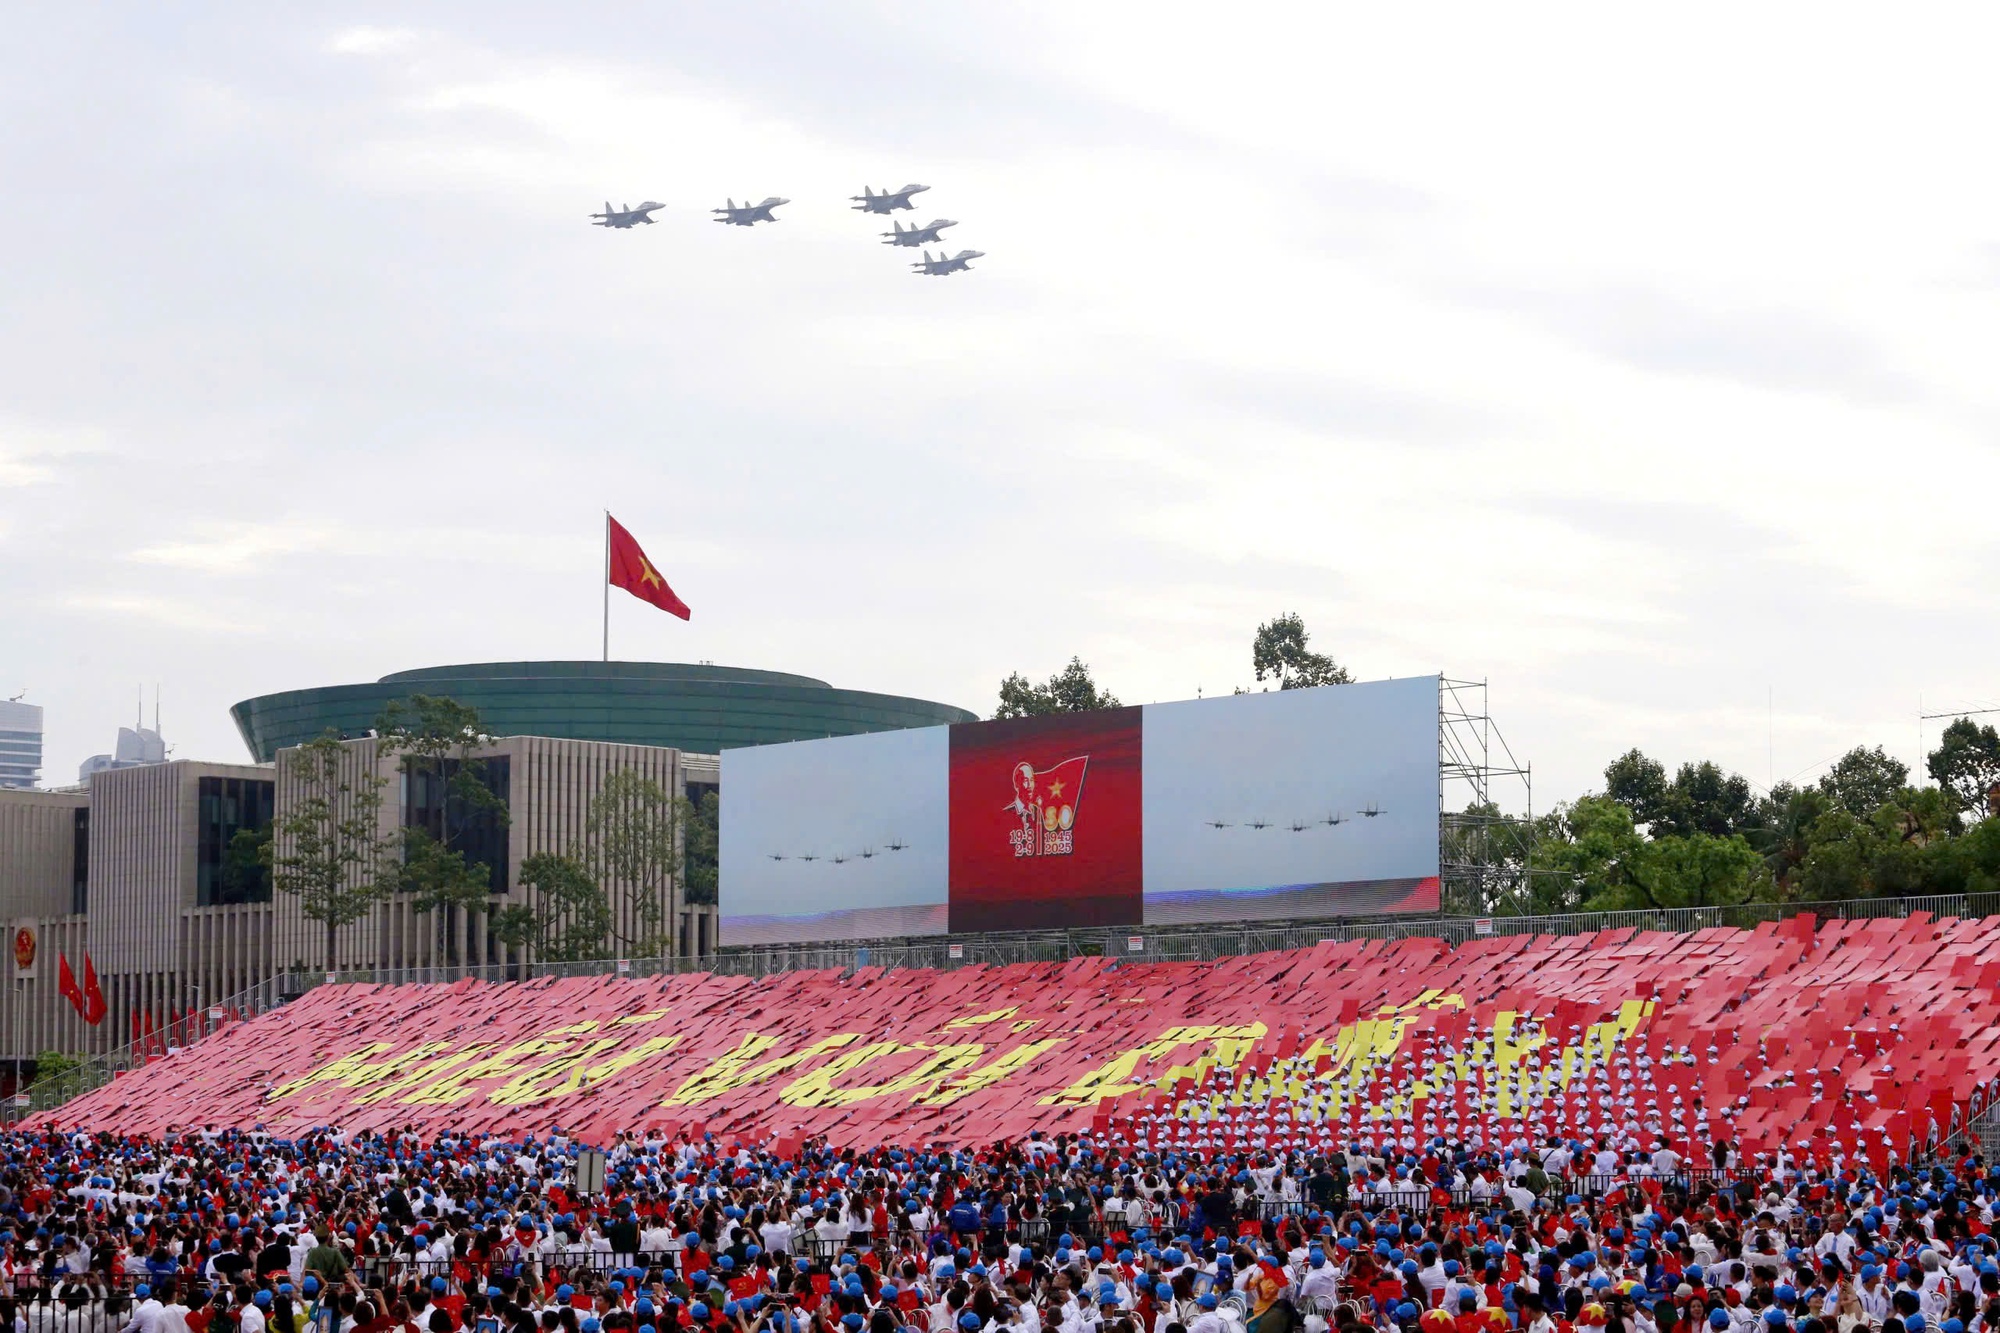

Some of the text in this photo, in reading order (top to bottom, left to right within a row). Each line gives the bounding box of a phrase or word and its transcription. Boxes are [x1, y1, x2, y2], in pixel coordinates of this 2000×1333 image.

[1044, 830, 1072, 843] 1945
[1044, 841, 1072, 854] 2025
[266, 1007, 684, 1106] HIẾU
[660, 1006, 1070, 1107] VỚI
